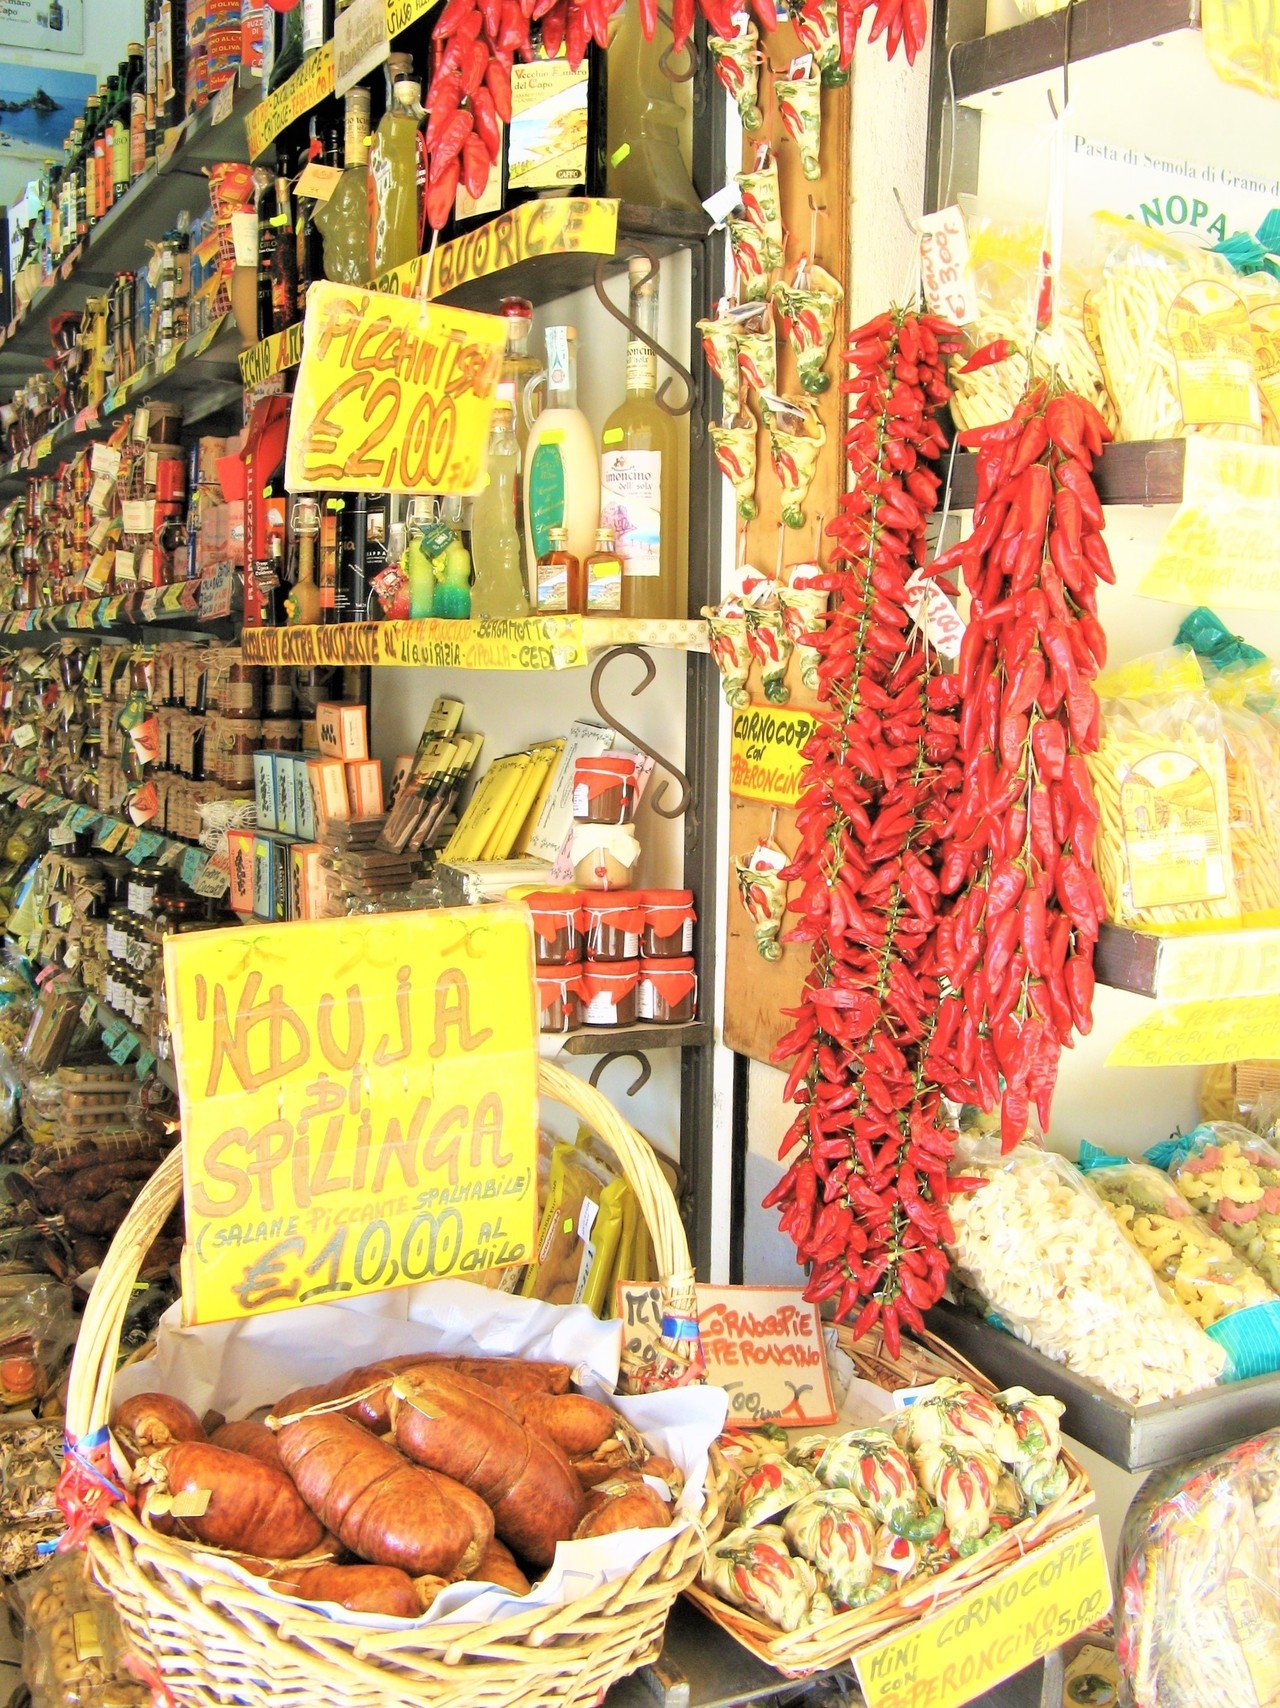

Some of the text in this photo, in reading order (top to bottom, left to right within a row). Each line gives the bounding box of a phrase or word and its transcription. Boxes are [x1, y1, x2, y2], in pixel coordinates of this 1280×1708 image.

[1074, 135, 1118, 161] Pasta
[1123, 149, 1138, 166] di
[1143, 152, 1197, 179] Semola
[1201, 165, 1216, 183] di
[1220, 168, 1267, 194] Grano
[746, 745, 767, 761] CON
[302, 1062, 366, 1118] Di
[193, 1090, 513, 1218] SPiLiNGA
[477, 1217, 507, 1246] AL
[880, 1665, 919, 1695] CON
